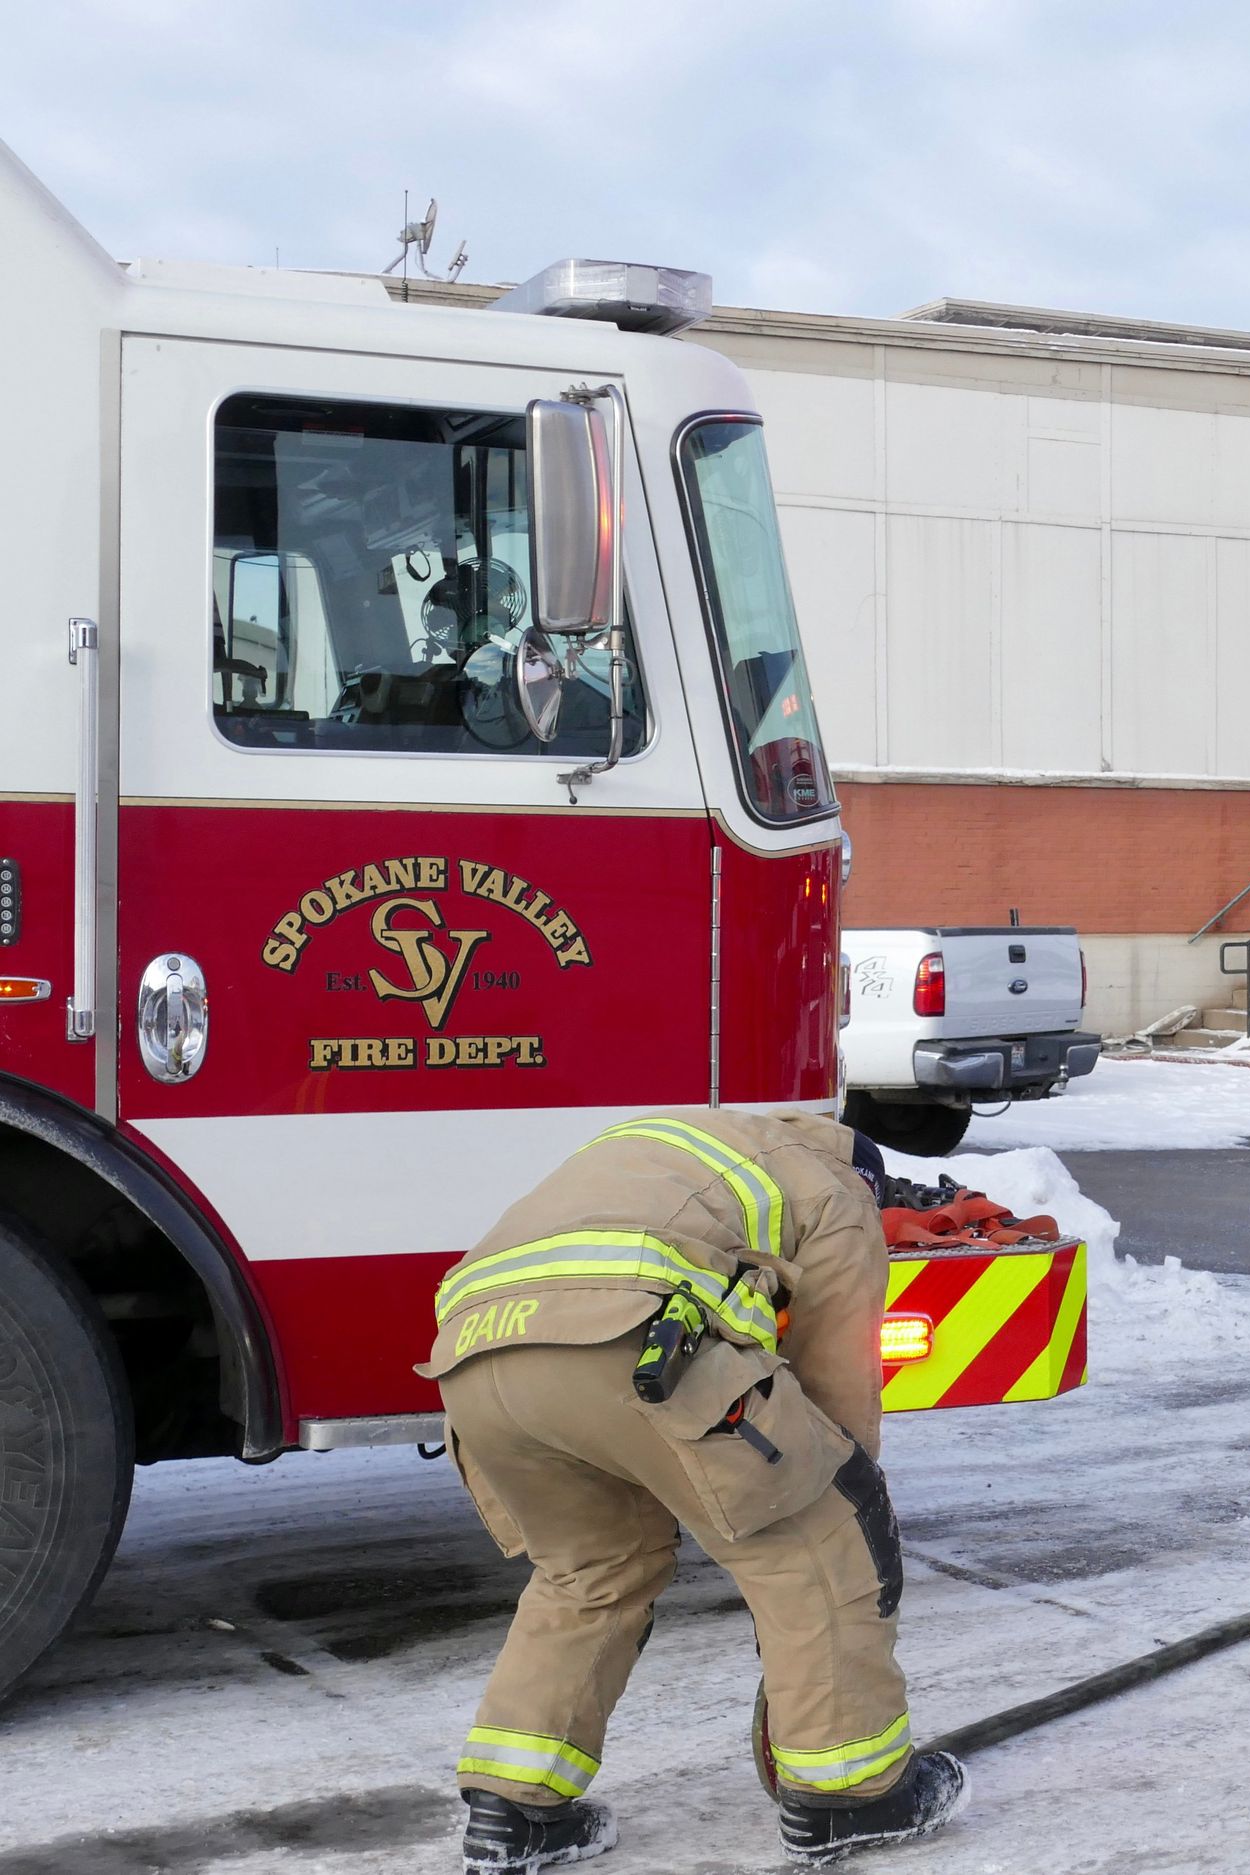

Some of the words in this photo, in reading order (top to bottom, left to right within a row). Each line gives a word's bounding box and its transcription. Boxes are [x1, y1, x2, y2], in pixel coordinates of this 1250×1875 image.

[793, 789, 816, 798] KME
[261, 856, 448, 974] SPOKANE
[458, 858, 593, 969] VALLEY
[326, 971, 368, 992] Est.
[472, 971, 521, 991] 1940
[309, 1037, 418, 1071] FIRE
[425, 1036, 547, 1068] DEPT.
[455, 1298, 540, 1357] BAIR
